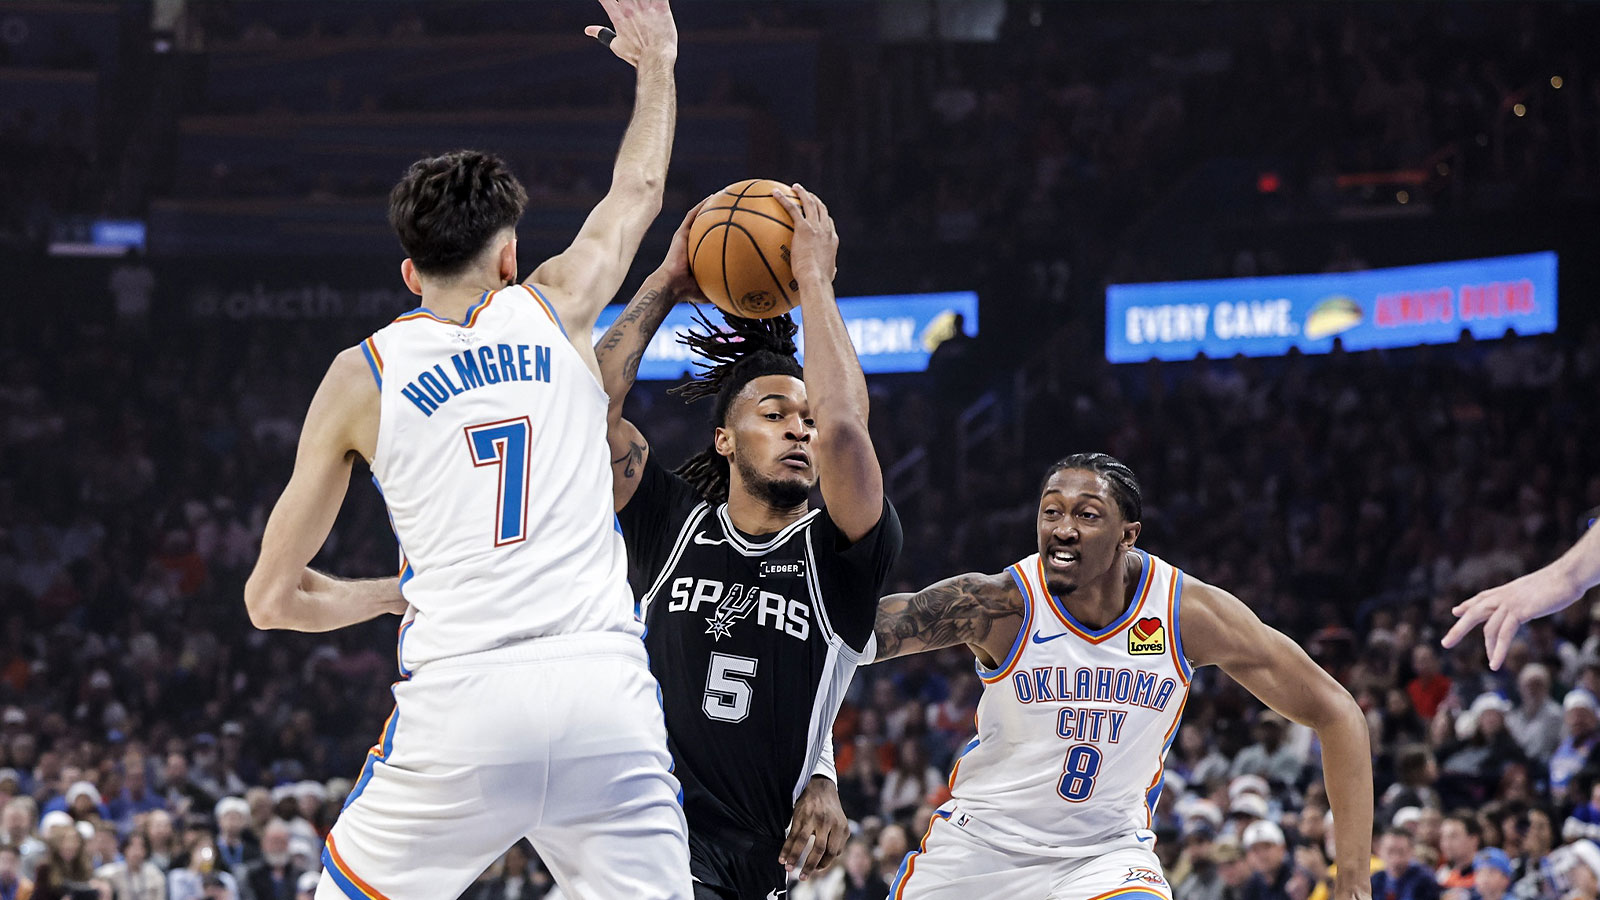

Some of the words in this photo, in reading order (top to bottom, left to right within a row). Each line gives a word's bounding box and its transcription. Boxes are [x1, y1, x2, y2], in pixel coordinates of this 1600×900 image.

[1125, 303, 1209, 344] EVERY
[401, 344, 551, 417] HOLMGREN
[464, 415, 532, 548] 7
[765, 564, 799, 573] LEDGER
[668, 576, 810, 642] SPURS
[702, 651, 758, 723] 5
[1012, 666, 1177, 712] OKLAHOMA
[1056, 707, 1128, 743] CITY
[1056, 743, 1103, 803] 8
